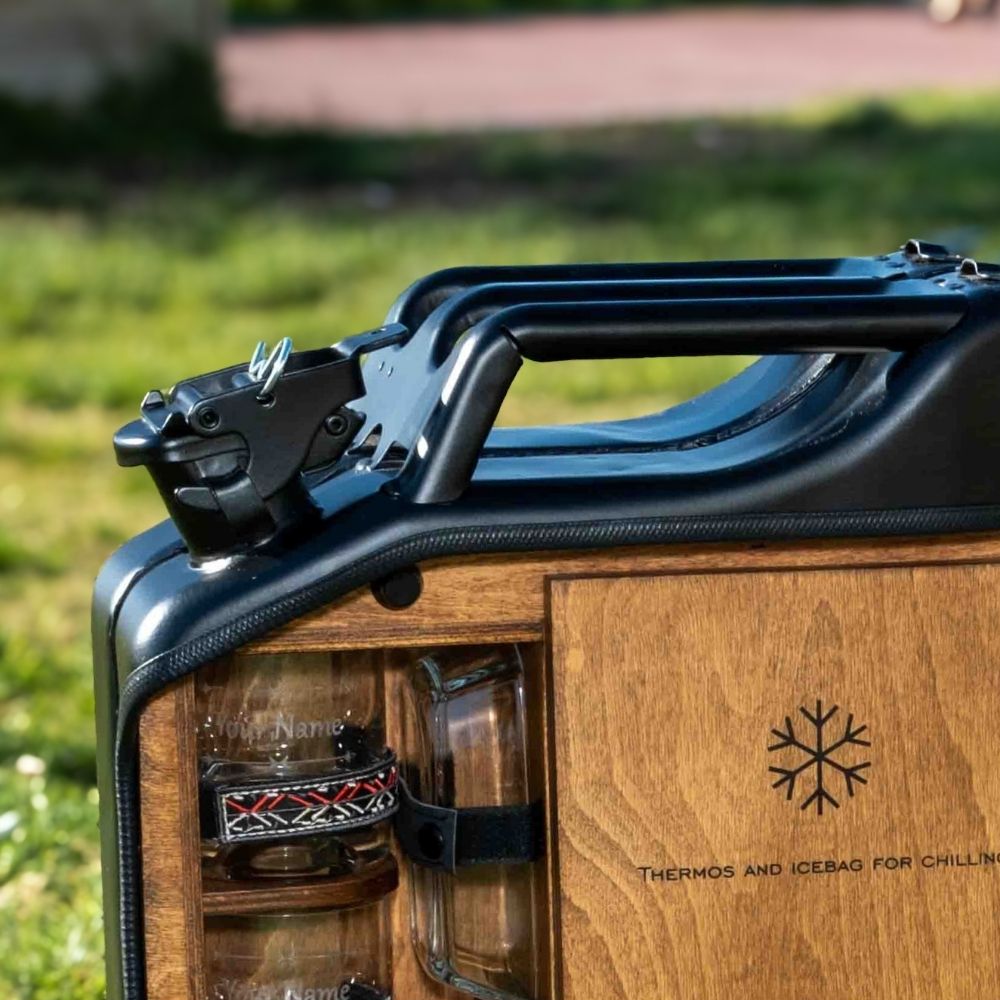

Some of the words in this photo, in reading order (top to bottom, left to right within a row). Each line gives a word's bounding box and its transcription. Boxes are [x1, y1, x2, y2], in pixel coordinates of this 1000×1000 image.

[275, 711, 343, 740] Name
[744, 863, 782, 877] AND
[791, 859, 863, 875] ICEBAG
[873, 856, 912, 871] FOR
